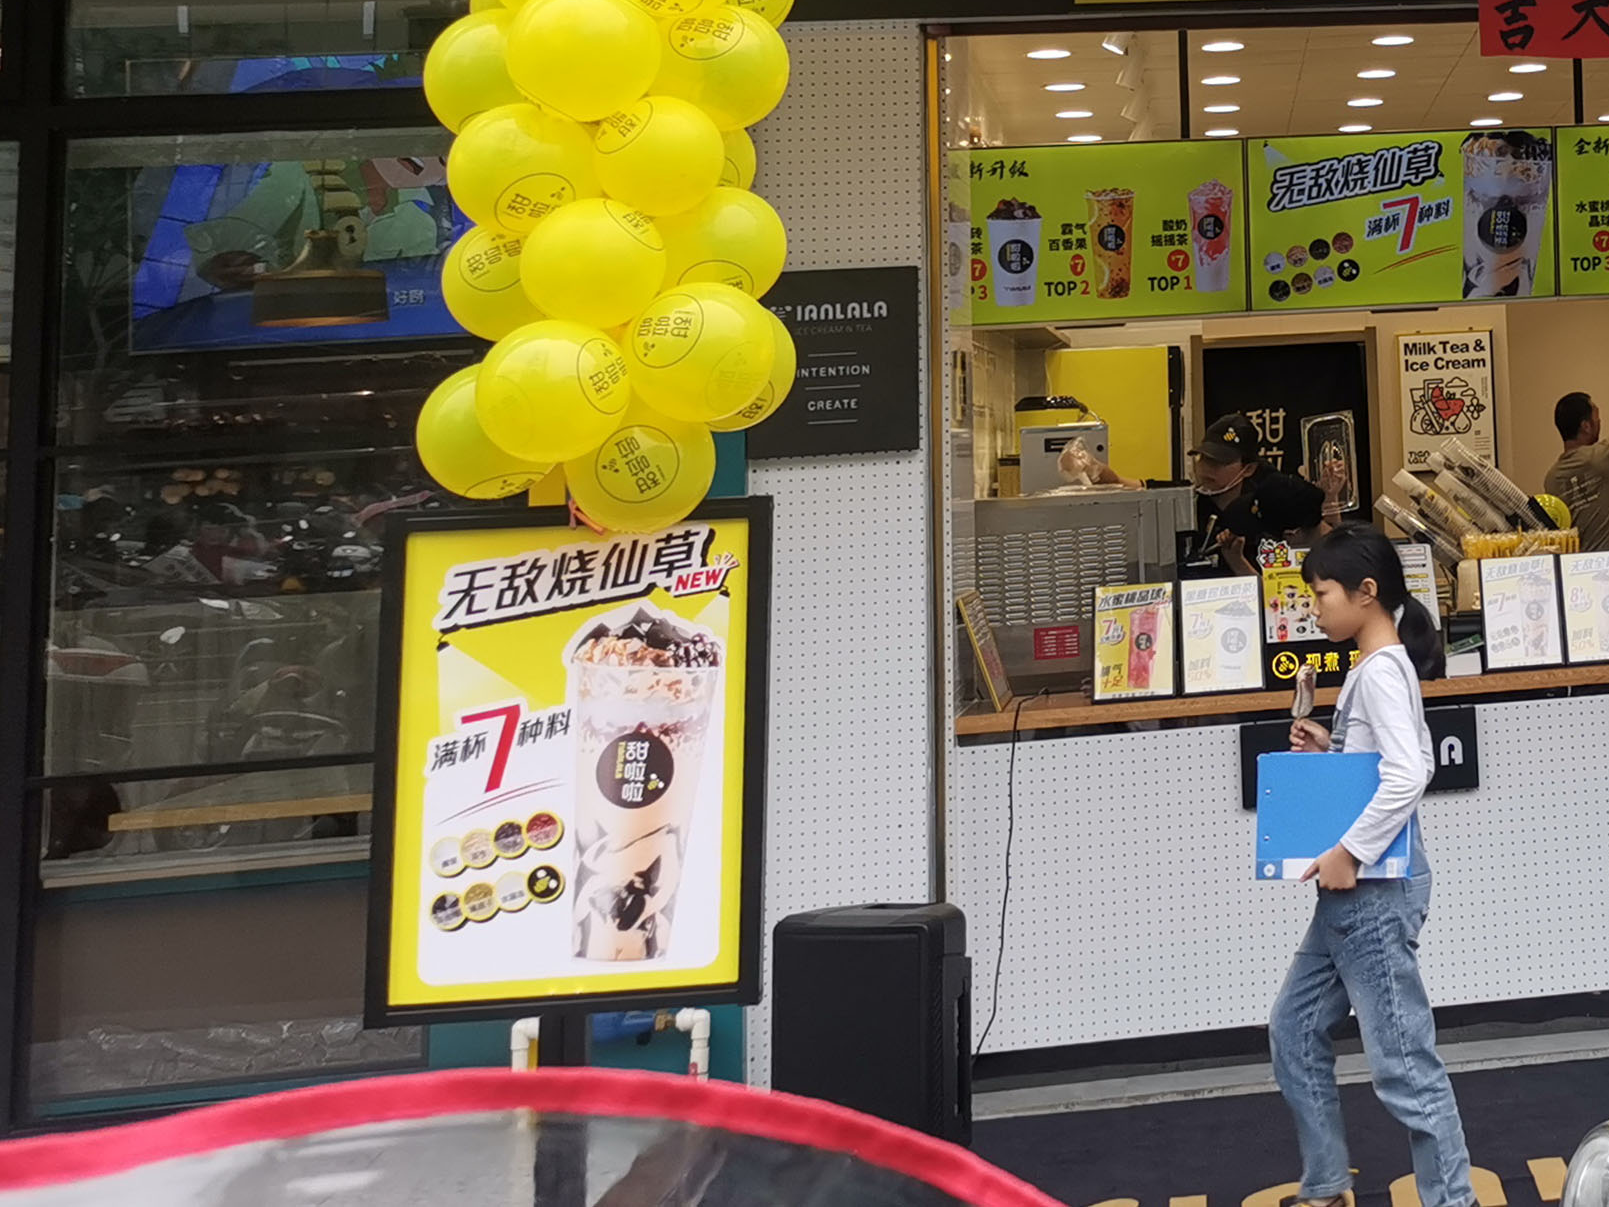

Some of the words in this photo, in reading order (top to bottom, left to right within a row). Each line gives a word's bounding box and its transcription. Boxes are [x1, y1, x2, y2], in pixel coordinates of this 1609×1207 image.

[1268, 141, 1442, 211] 无敌烧仙草
[1048, 239, 1088, 252] 百香果
[1571, 257, 1601, 271] TOP
[1044, 281, 1078, 297] TOP
[1080, 280, 1090, 296] 2
[1148, 276, 1180, 292] TOP
[1184, 275, 1193, 291] 1
[1404, 342, 1437, 356] Milk
[1439, 340, 1470, 354] Tea
[1473, 338, 1486, 352] &
[797, 364, 871, 378] INTENTION
[1405, 358, 1430, 372] Ice
[1434, 356, 1486, 370] Cream
[807, 398, 858, 411] CREATE
[614, 435, 661, 494] 甜啦啦
[441, 527, 702, 623] 无敌烧仙草
[675, 566, 725, 591] NEW
[430, 702, 572, 794] 满杯7种料
